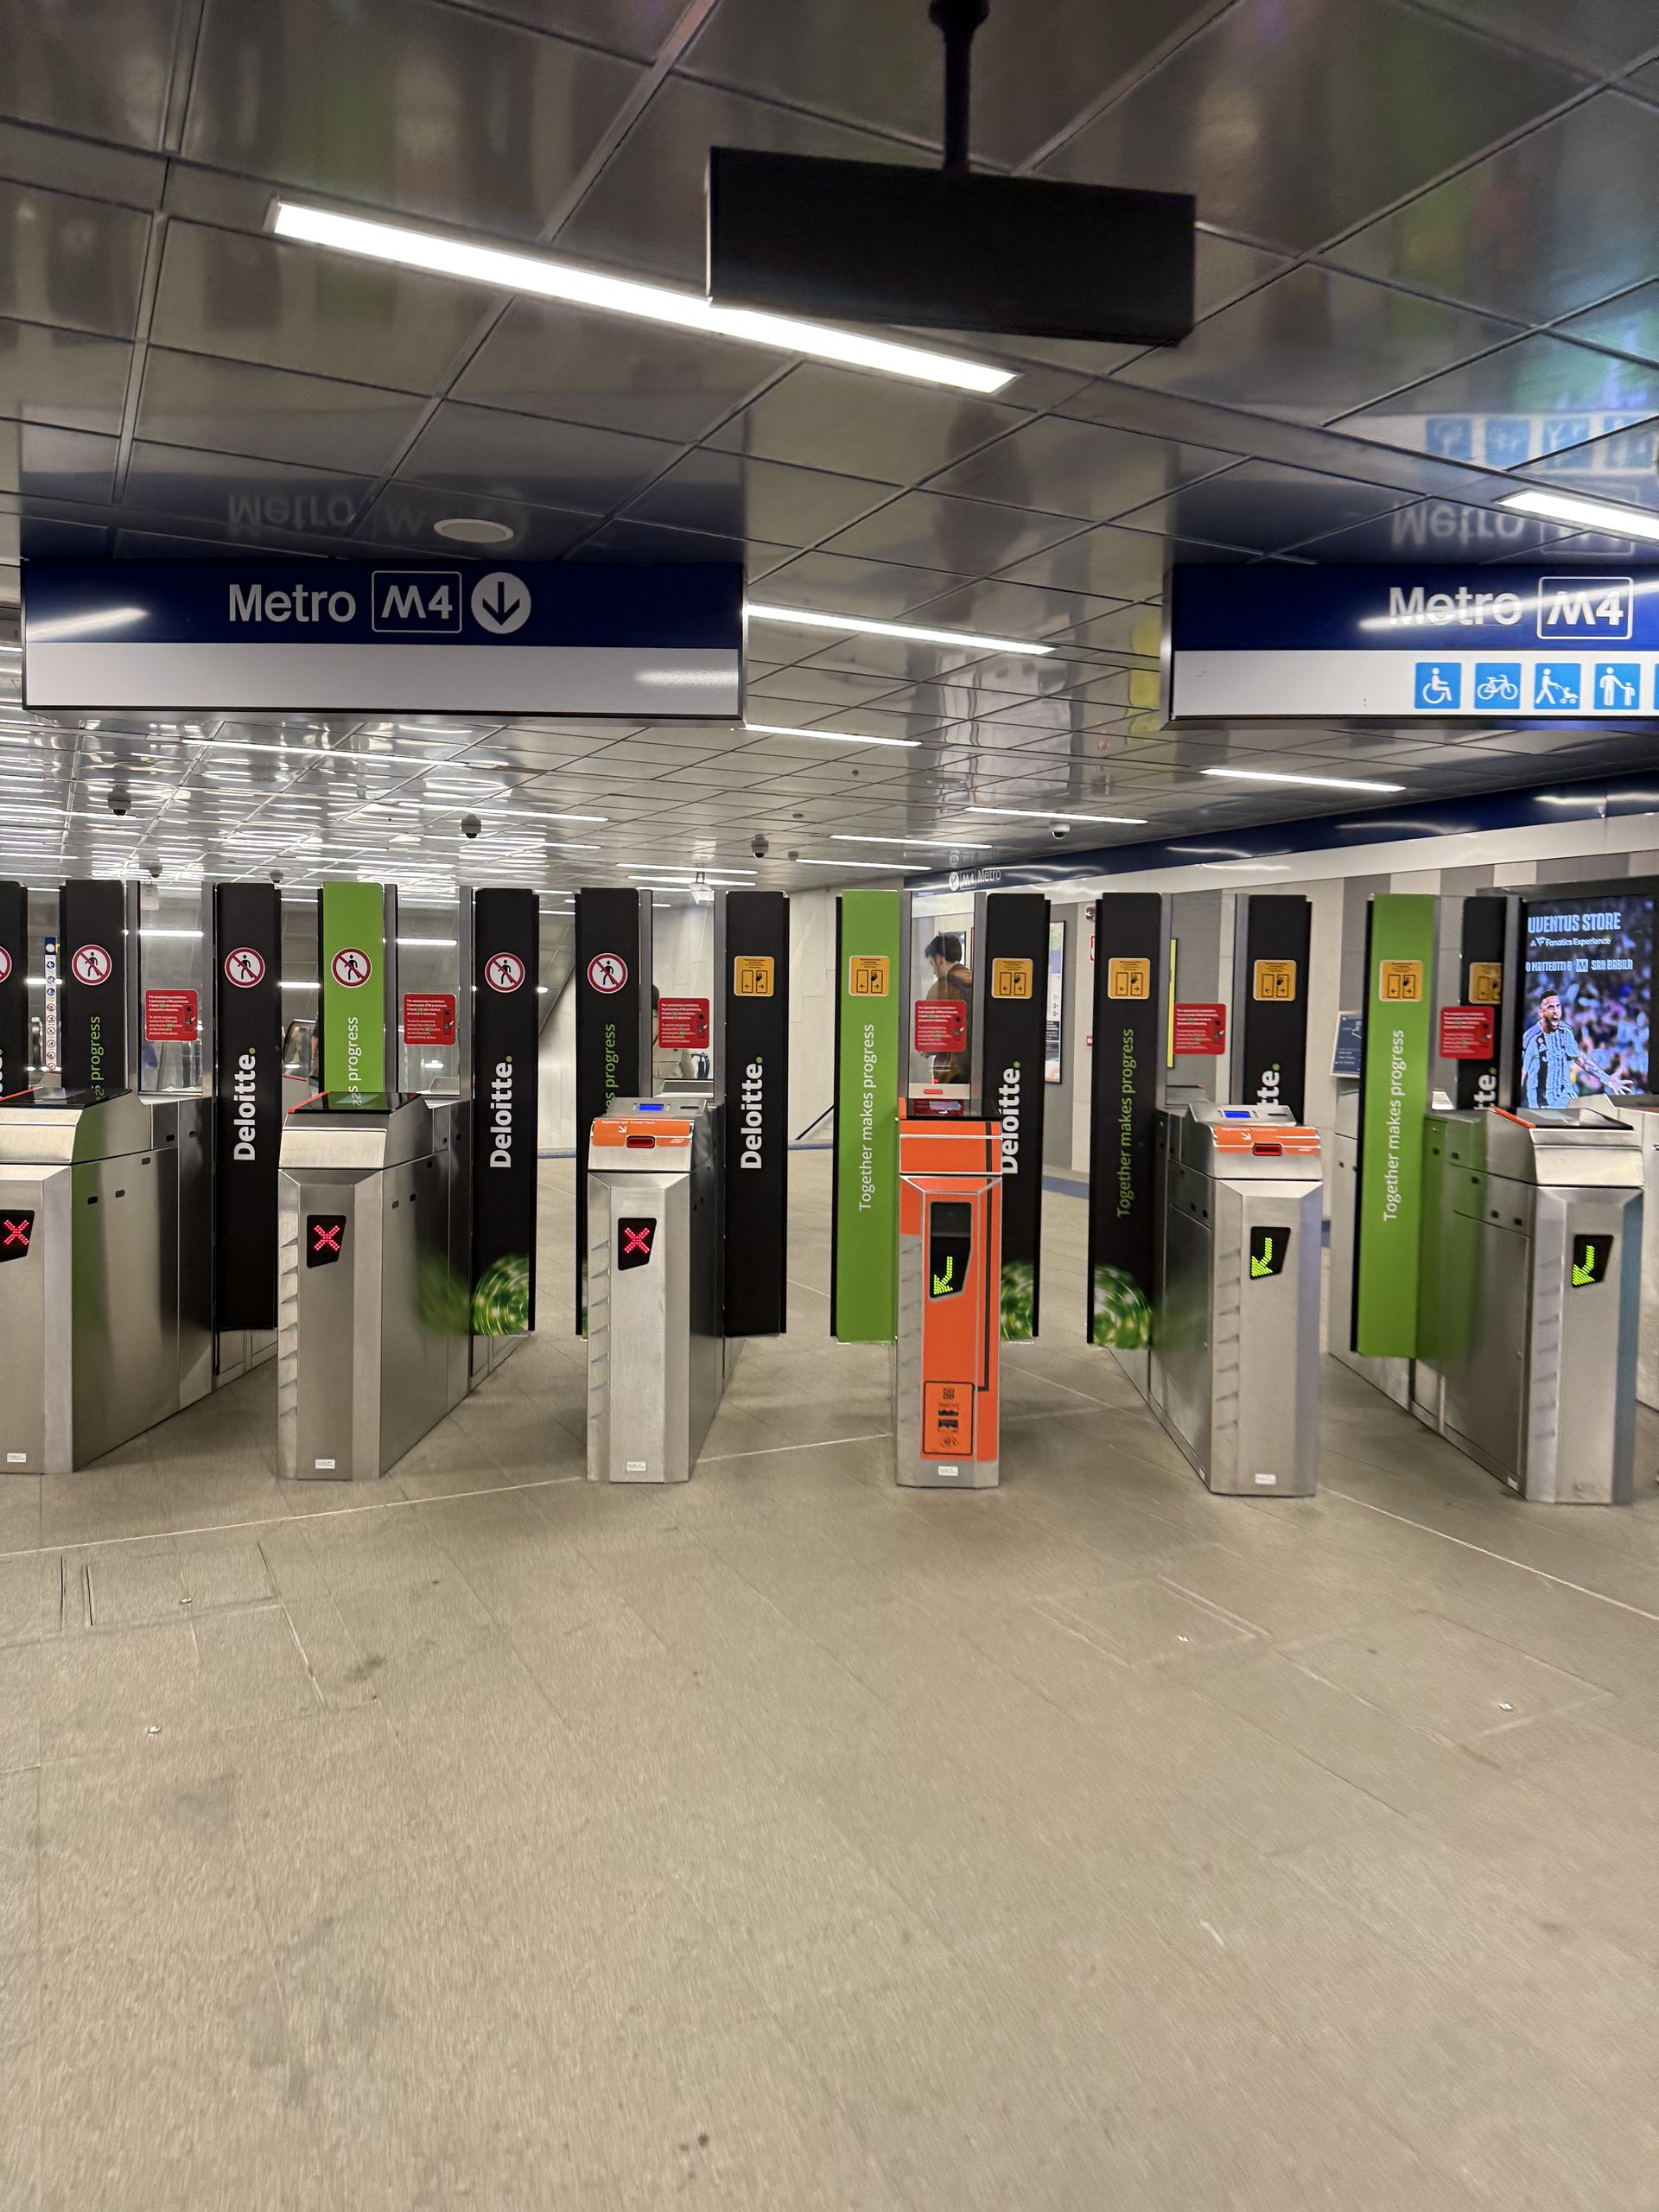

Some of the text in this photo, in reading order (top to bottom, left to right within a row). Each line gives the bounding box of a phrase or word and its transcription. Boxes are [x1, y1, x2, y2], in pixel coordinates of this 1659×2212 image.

[229, 584, 453, 622] Metro M4
[1389, 586, 1624, 626] Metro M4
[977, 869, 1001, 883] Metro
[1545, 938, 1573, 947] Fanatics
[1573, 937, 1611, 947] Experience
[1581, 912, 1622, 931] STORE
[1591, 959, 1606, 970] SAN
[1607, 958, 1633, 970] BABILA
[91, 1016, 104, 1080] progress
[348, 1017, 362, 1081] progress
[605, 1024, 619, 1088] progress
[233, 1047, 256, 1160] Deloitte.
[490, 1055, 512, 1168] Deloitte.
[741, 1056, 763, 1169] Deloitte.
[859, 1024, 877, 1211] Together makes progress
[1117, 1028, 1136, 1217] Together makes progress
[1383, 1030, 1407, 1221] Together makes progress
